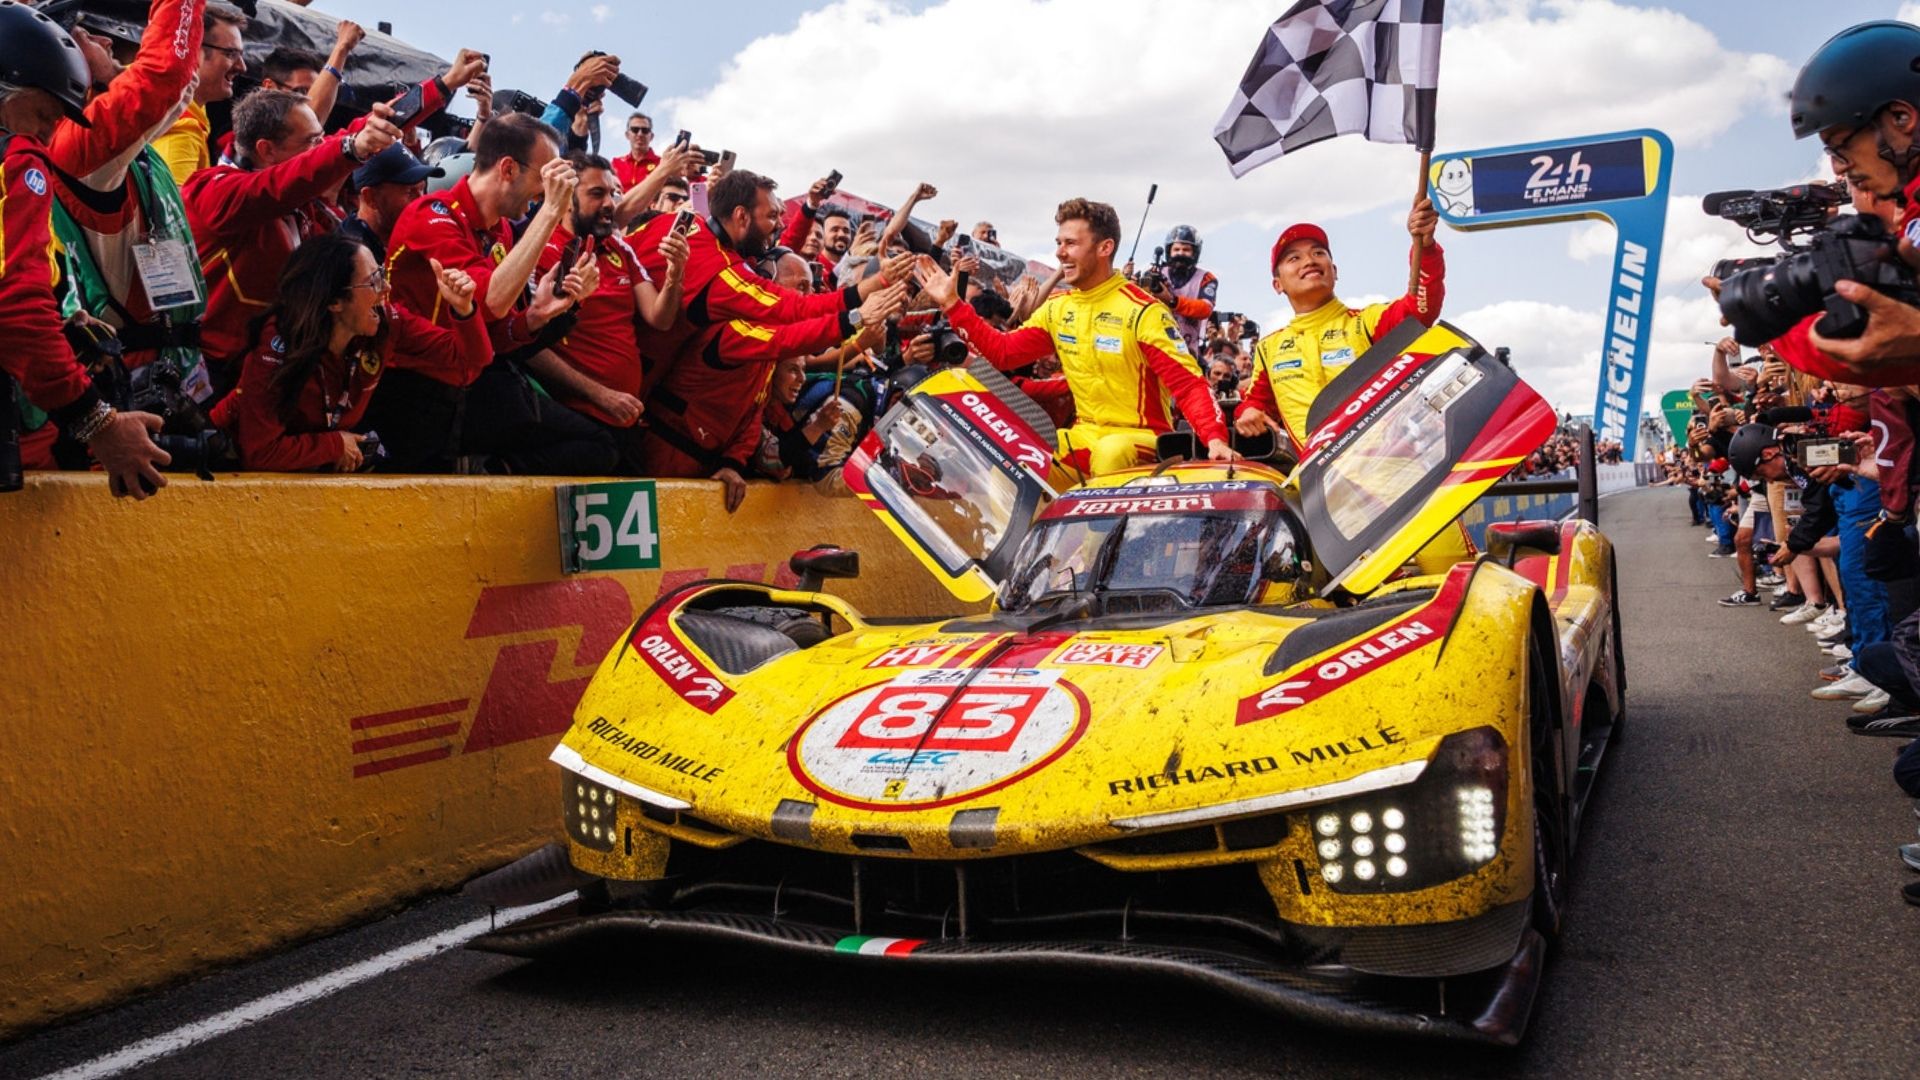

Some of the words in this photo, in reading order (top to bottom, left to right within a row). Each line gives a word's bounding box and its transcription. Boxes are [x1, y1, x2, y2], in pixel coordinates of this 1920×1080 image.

[1524, 189, 1542, 199] LE
[1545, 184, 1588, 196] MANS
[1526, 151, 1591, 188] 24h
[1344, 354, 1415, 416] ORLEN
[961, 393, 1020, 444] ORLEN
[1064, 494, 1216, 516] Ferrari
[1147, 484, 1213, 493] POZZI
[574, 490, 657, 561] 54
[640, 635, 698, 680] ORLEN
[1063, 650, 1147, 665] CAR
[1074, 643, 1163, 651] HYPER
[1317, 620, 1434, 680] ORLEN
[858, 692, 1032, 740] 83
[587, 716, 660, 760] RICHARD
[653, 752, 725, 784] MILLE
[867, 751, 960, 764] WEC
[1108, 755, 1278, 796] RICHARD
[1290, 726, 1405, 766] MILLE
